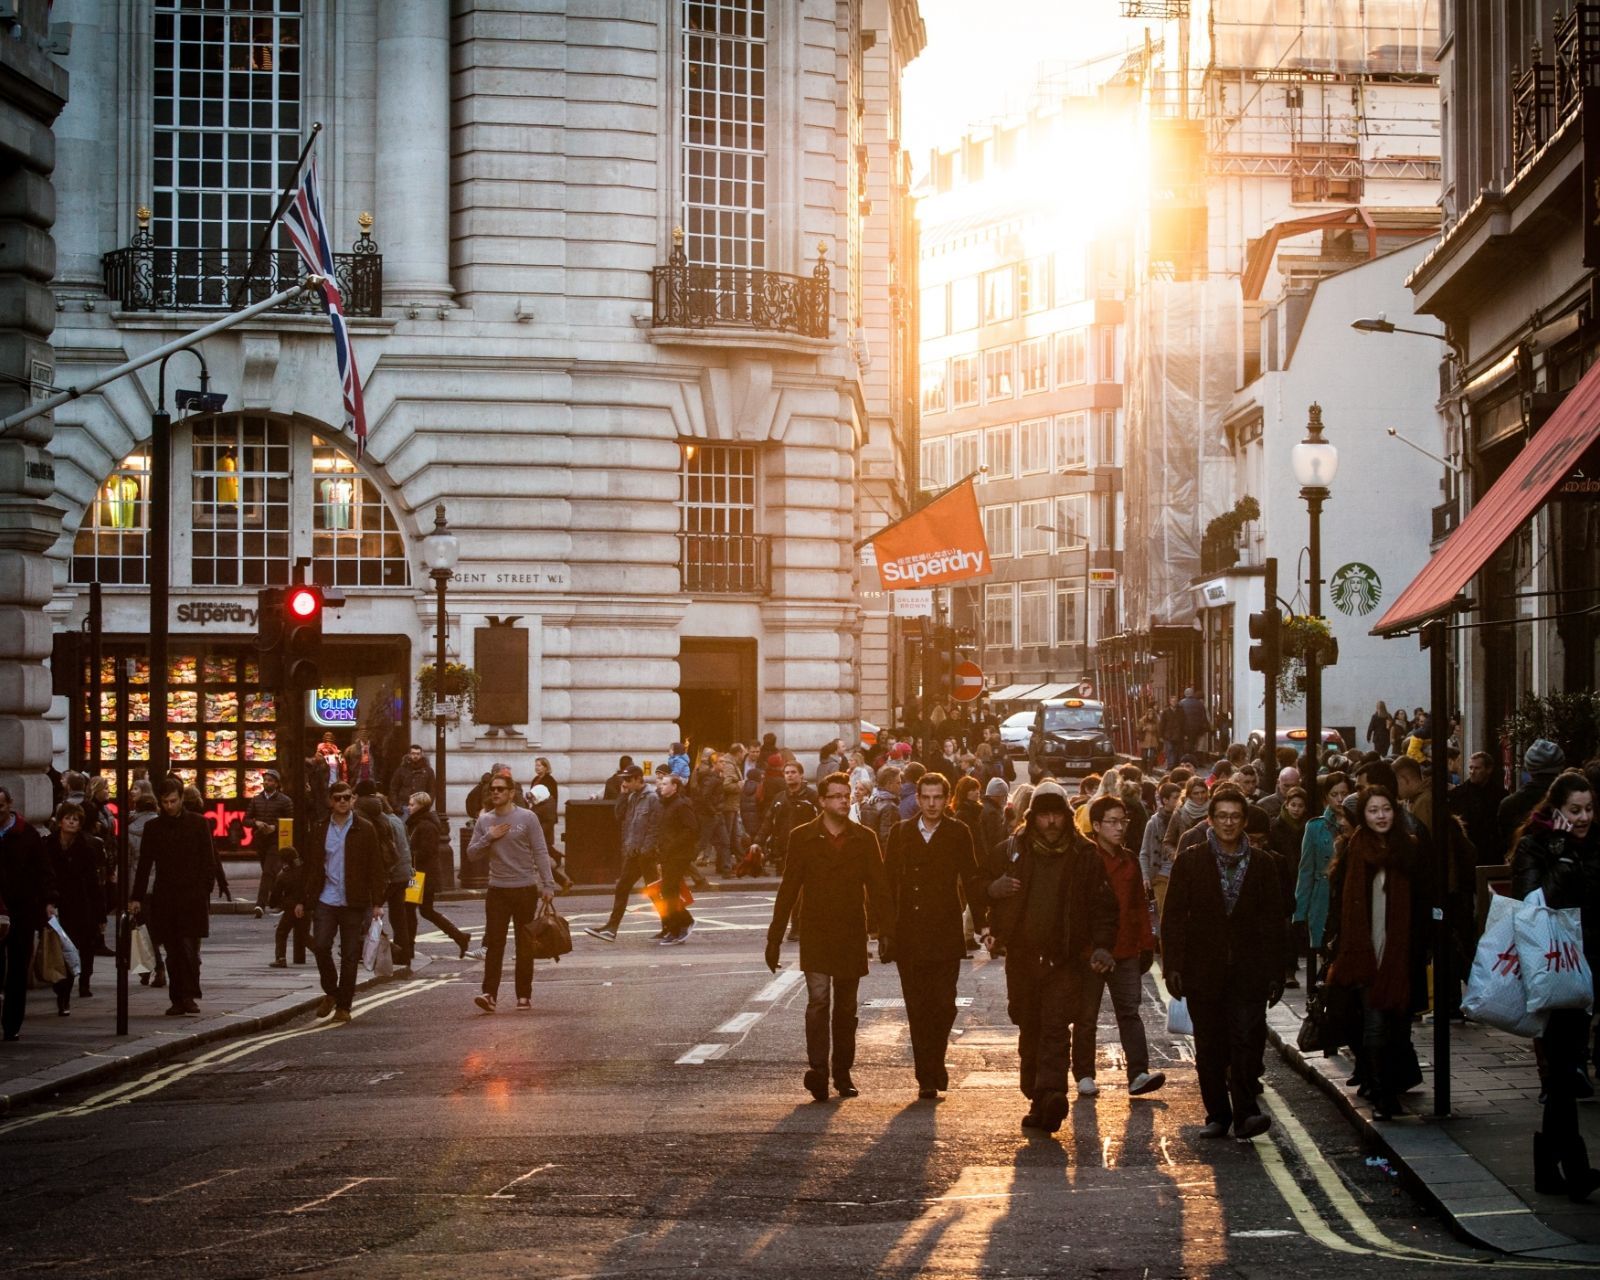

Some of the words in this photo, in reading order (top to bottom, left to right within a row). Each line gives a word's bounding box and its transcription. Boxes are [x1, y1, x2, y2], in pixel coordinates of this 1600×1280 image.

[882, 549, 984, 583] Superdry
[496, 573, 540, 584] STREET
[177, 603, 259, 627] Superdry
[317, 688, 354, 700] T-SHIRT
[319, 698, 359, 710] GALLERY
[1544, 938, 1583, 974] H&M
